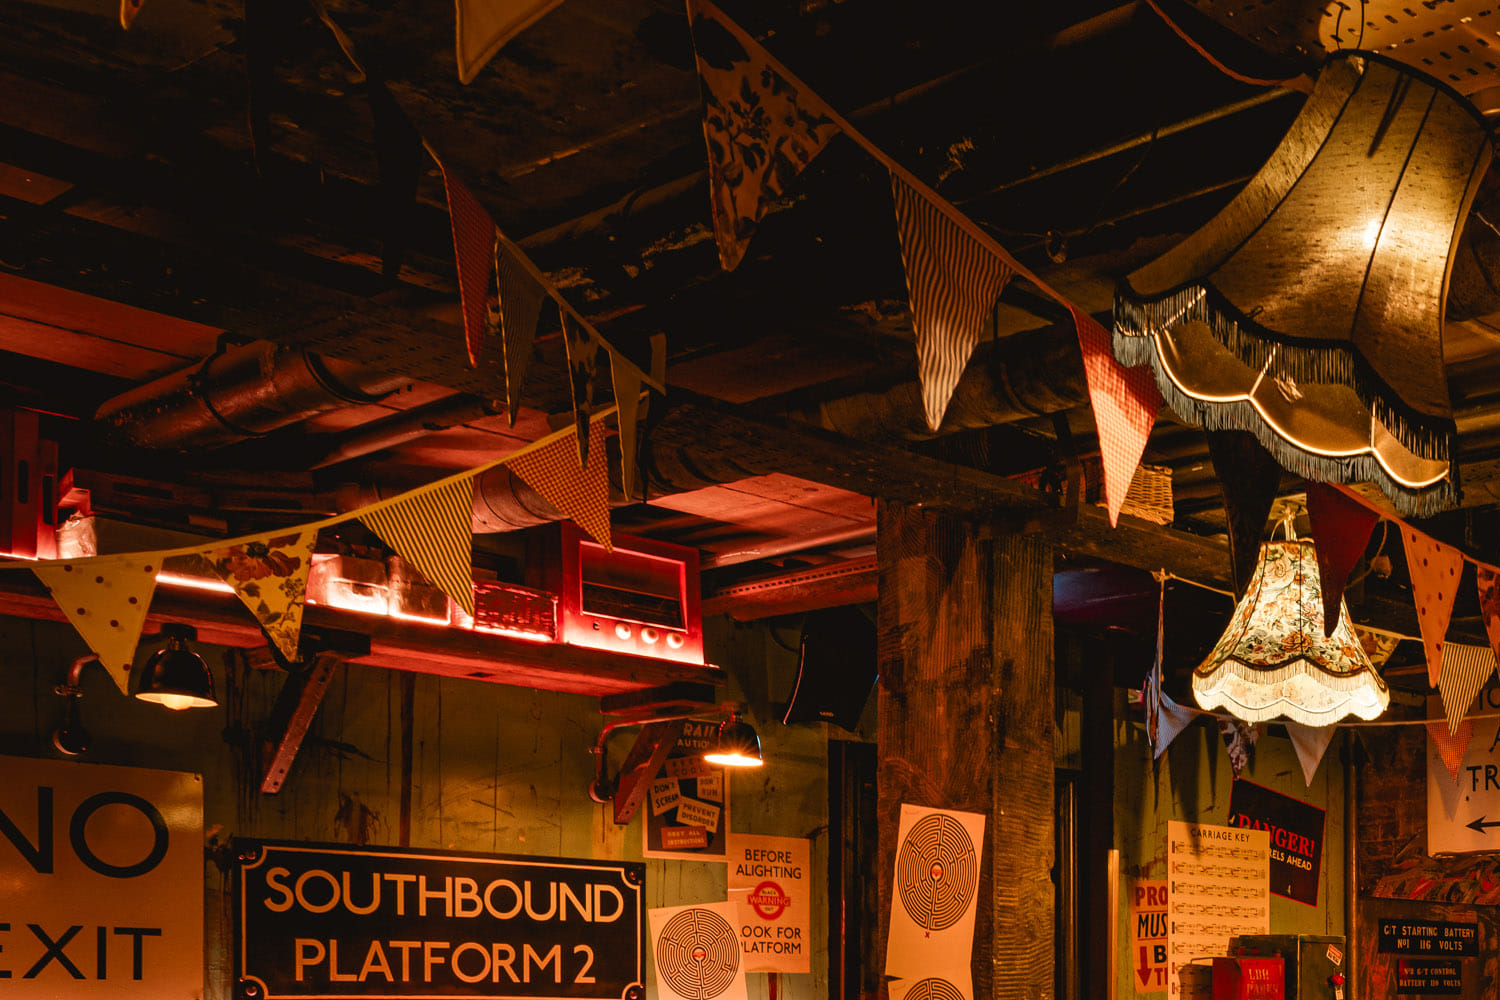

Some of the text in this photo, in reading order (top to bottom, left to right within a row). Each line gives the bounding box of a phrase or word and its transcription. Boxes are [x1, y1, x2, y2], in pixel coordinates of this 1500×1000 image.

[1190, 827, 1251, 843] CARRIAGE KEY
[744, 849, 793, 864] BEFORE
[1286, 854, 1313, 872] AHEAD
[735, 864, 802, 880] ALIGHTING
[263, 866, 624, 924] SOUTHBOUND
[739, 925, 801, 939] OOK FOR
[1401, 926, 1438, 937] STARTING
[1444, 927, 1475, 939] BATTERY
[740, 940, 801, 955] LATFORM
[1439, 940, 1463, 951] VOLTS
[294, 938, 596, 984] PLATFORM 2
